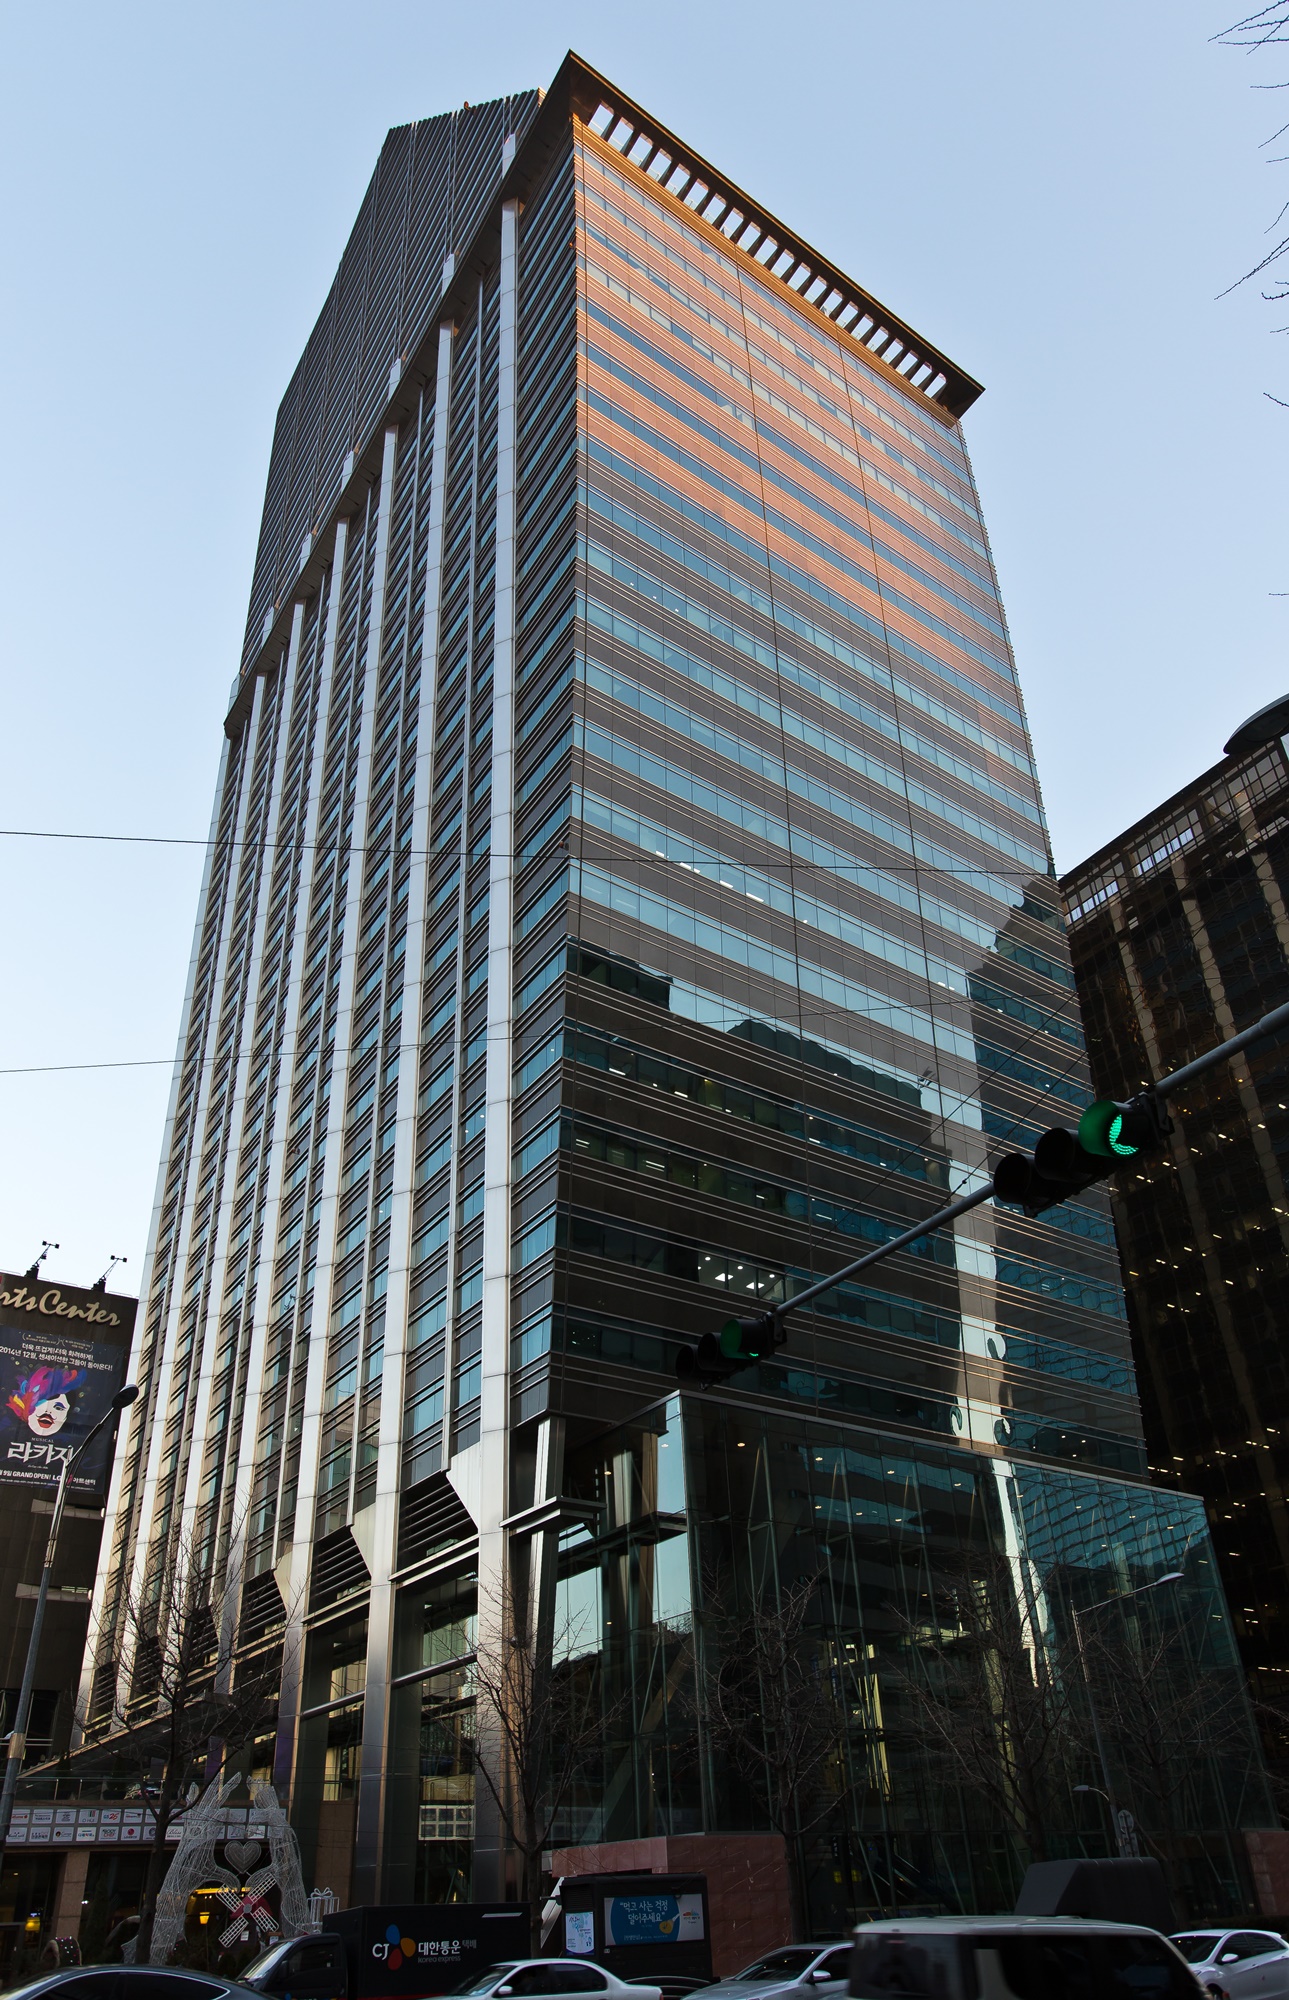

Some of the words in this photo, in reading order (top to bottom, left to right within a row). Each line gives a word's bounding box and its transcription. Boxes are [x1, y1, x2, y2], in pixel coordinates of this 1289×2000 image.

[639, 1900, 653, 1912] 사는
[655, 1899, 668, 1911] 걱정
[372, 1943, 390, 1961] CJ
[418, 1939, 462, 1956] 대한통운
